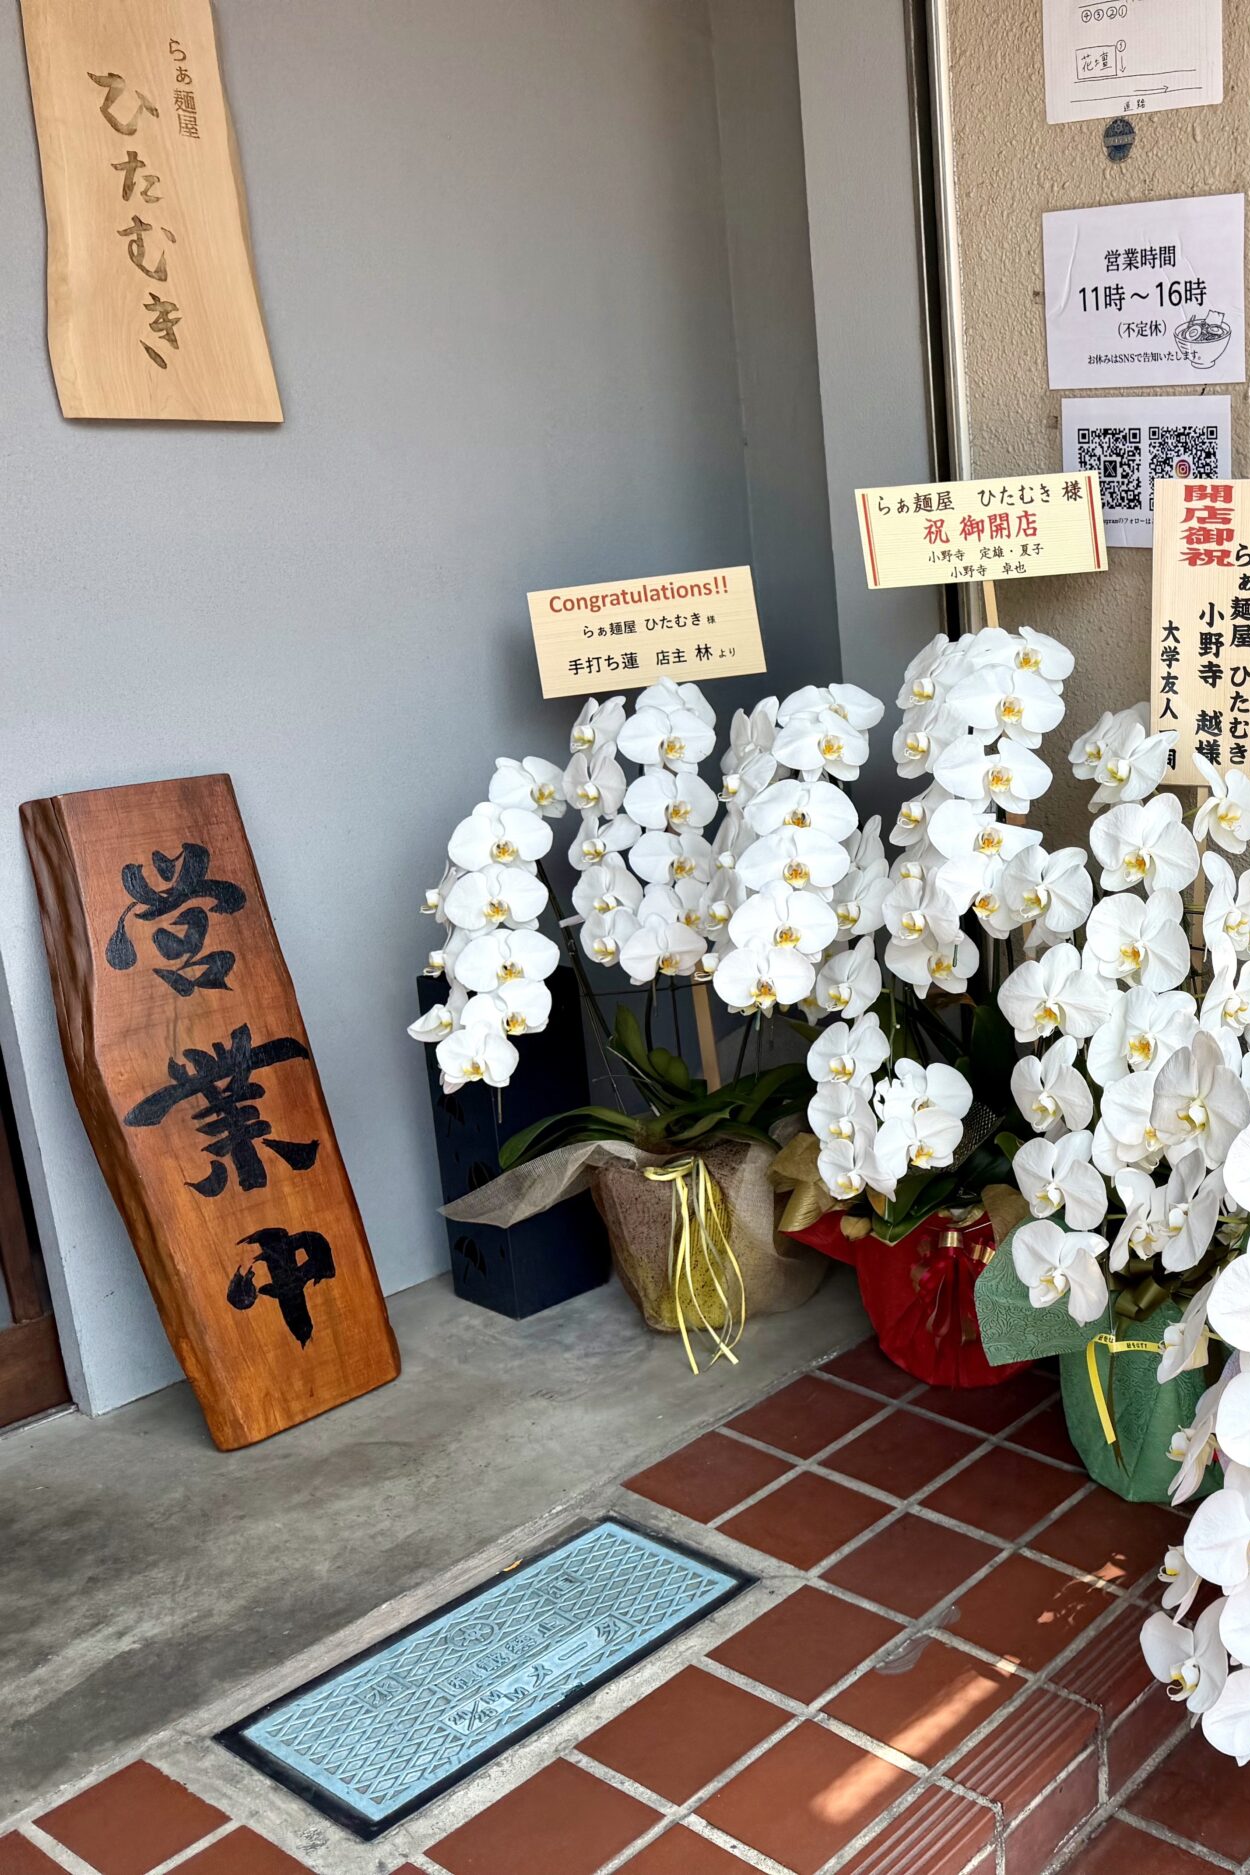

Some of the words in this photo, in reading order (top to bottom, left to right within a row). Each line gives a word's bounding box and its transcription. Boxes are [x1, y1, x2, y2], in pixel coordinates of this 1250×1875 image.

[168, 38, 200, 140] らぁ麺屋
[86, 71, 182, 370] ひたむき
[1104, 245, 1176, 273] 営業時間
[1087, 350, 1202, 366] お休みはSNSで告知いたします。
[877, 490, 955, 516] らぁ麺屋
[977, 483, 1051, 508] ひたむき
[1061, 480, 1084, 502] 様
[923, 517, 950, 545] 祝
[959, 510, 1040, 543] 御開店
[1178, 484, 1235, 567] 開店御祝
[928, 548, 966, 564] 小野寺
[979, 543, 1044, 560] 定雄・夏子
[950, 563, 988, 579] 小野寺
[1002, 561, 1027, 575] 卓也
[549, 575, 728, 613] Congratulations!!
[583, 620, 638, 639] らぁ麺屋
[644, 612, 702, 632] ひたむき
[706, 615, 717, 625] 様
[568, 652, 639, 676] 手打ち蓮
[656, 648, 687, 666] 店主
[694, 644, 714, 662] 林
[718, 648, 736, 659] より
[1198, 602, 1225, 689] 小野寺
[105, 842, 336, 1350] 営業中
